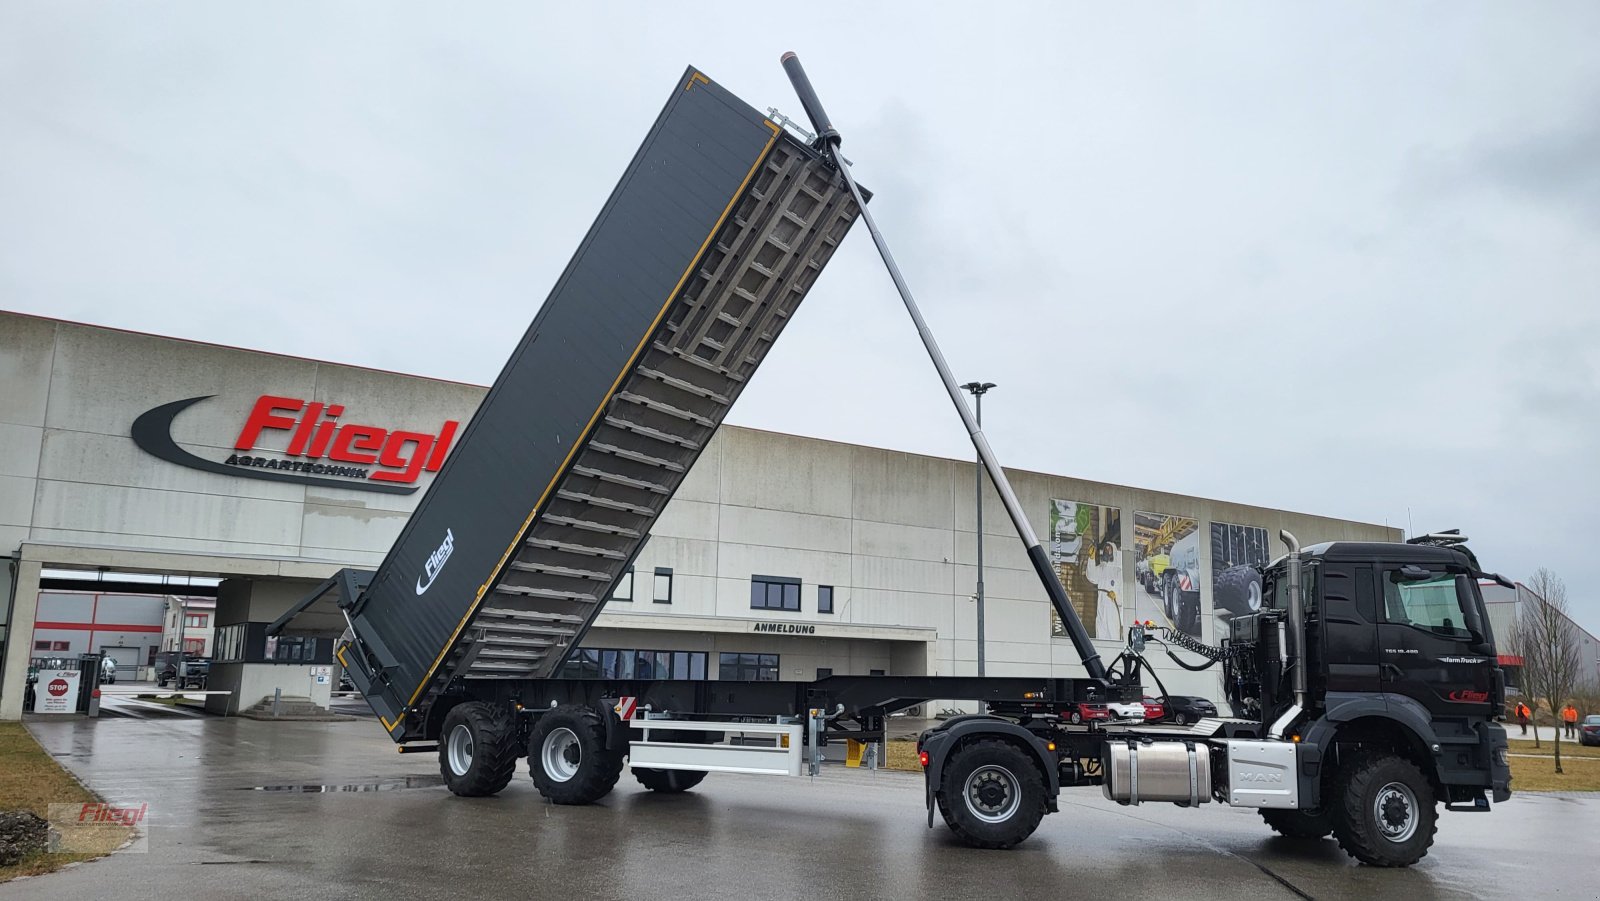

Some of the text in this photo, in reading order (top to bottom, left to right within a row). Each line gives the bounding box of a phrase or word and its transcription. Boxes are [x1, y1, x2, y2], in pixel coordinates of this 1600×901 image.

[234, 394, 459, 483] Fliegl
[225, 454, 368, 479] AGRARTECHNIK
[425, 528, 454, 578] Fliegl
[753, 622, 816, 635] ANMELDUNG
[1460, 690, 1489, 701] Fliegl
[1240, 772, 1282, 783] MAN
